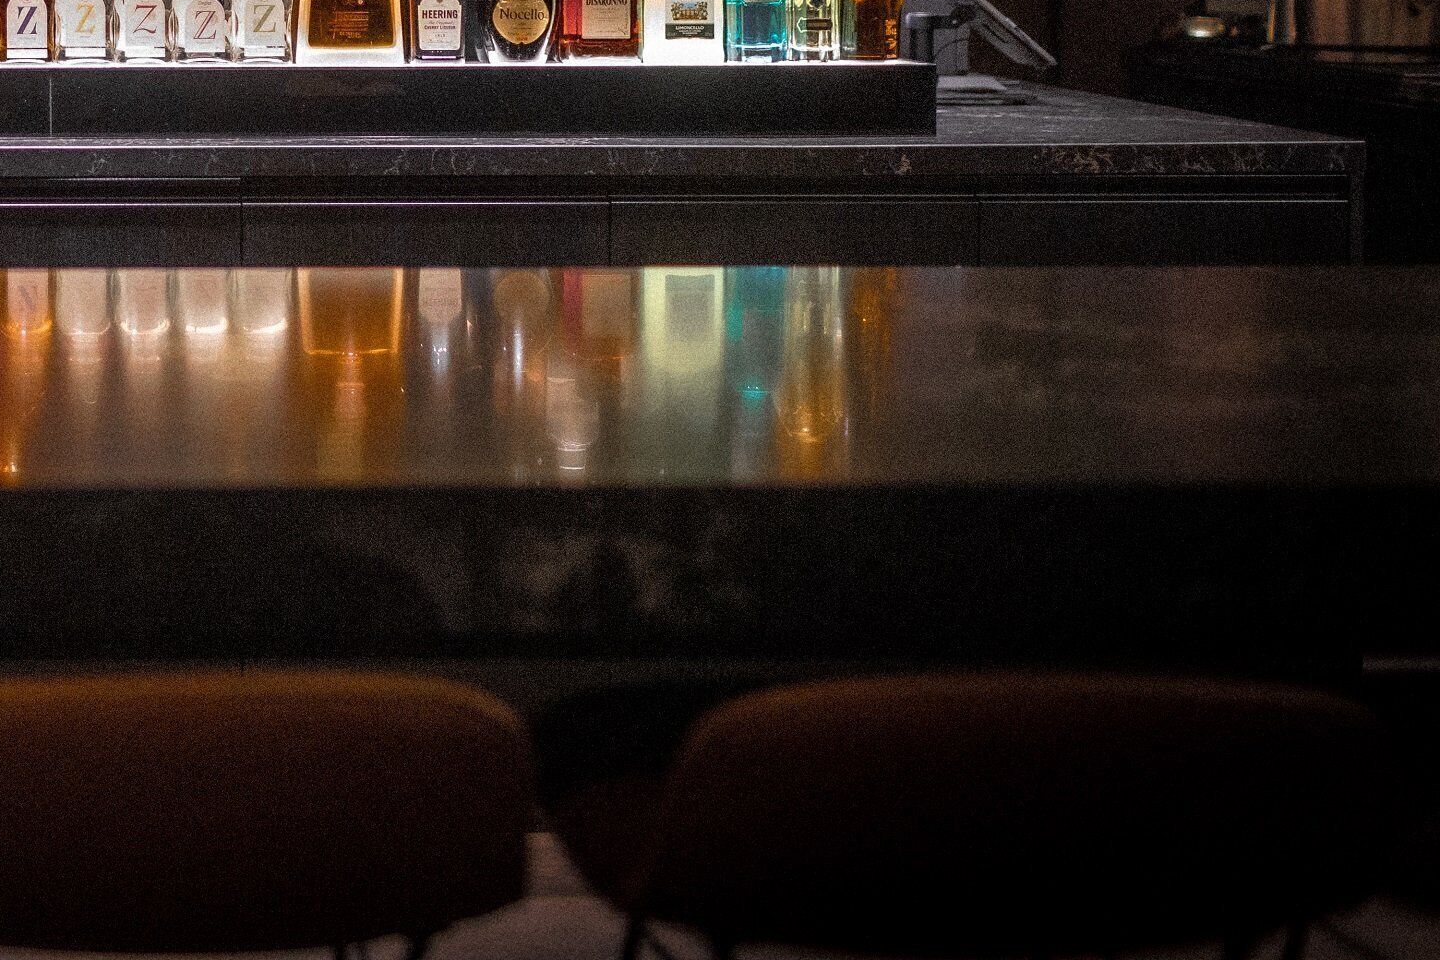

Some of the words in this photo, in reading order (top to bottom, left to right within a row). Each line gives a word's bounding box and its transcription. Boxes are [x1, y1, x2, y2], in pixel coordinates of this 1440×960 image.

[17, 6, 38, 34] Z
[74, 5, 96, 34] Z
[132, 4, 157, 34] Z
[193, 10, 217, 40] Z
[253, 4, 276, 33] Z
[422, 10, 458, 19] HEERING
[499, 8, 545, 20] Nocello
